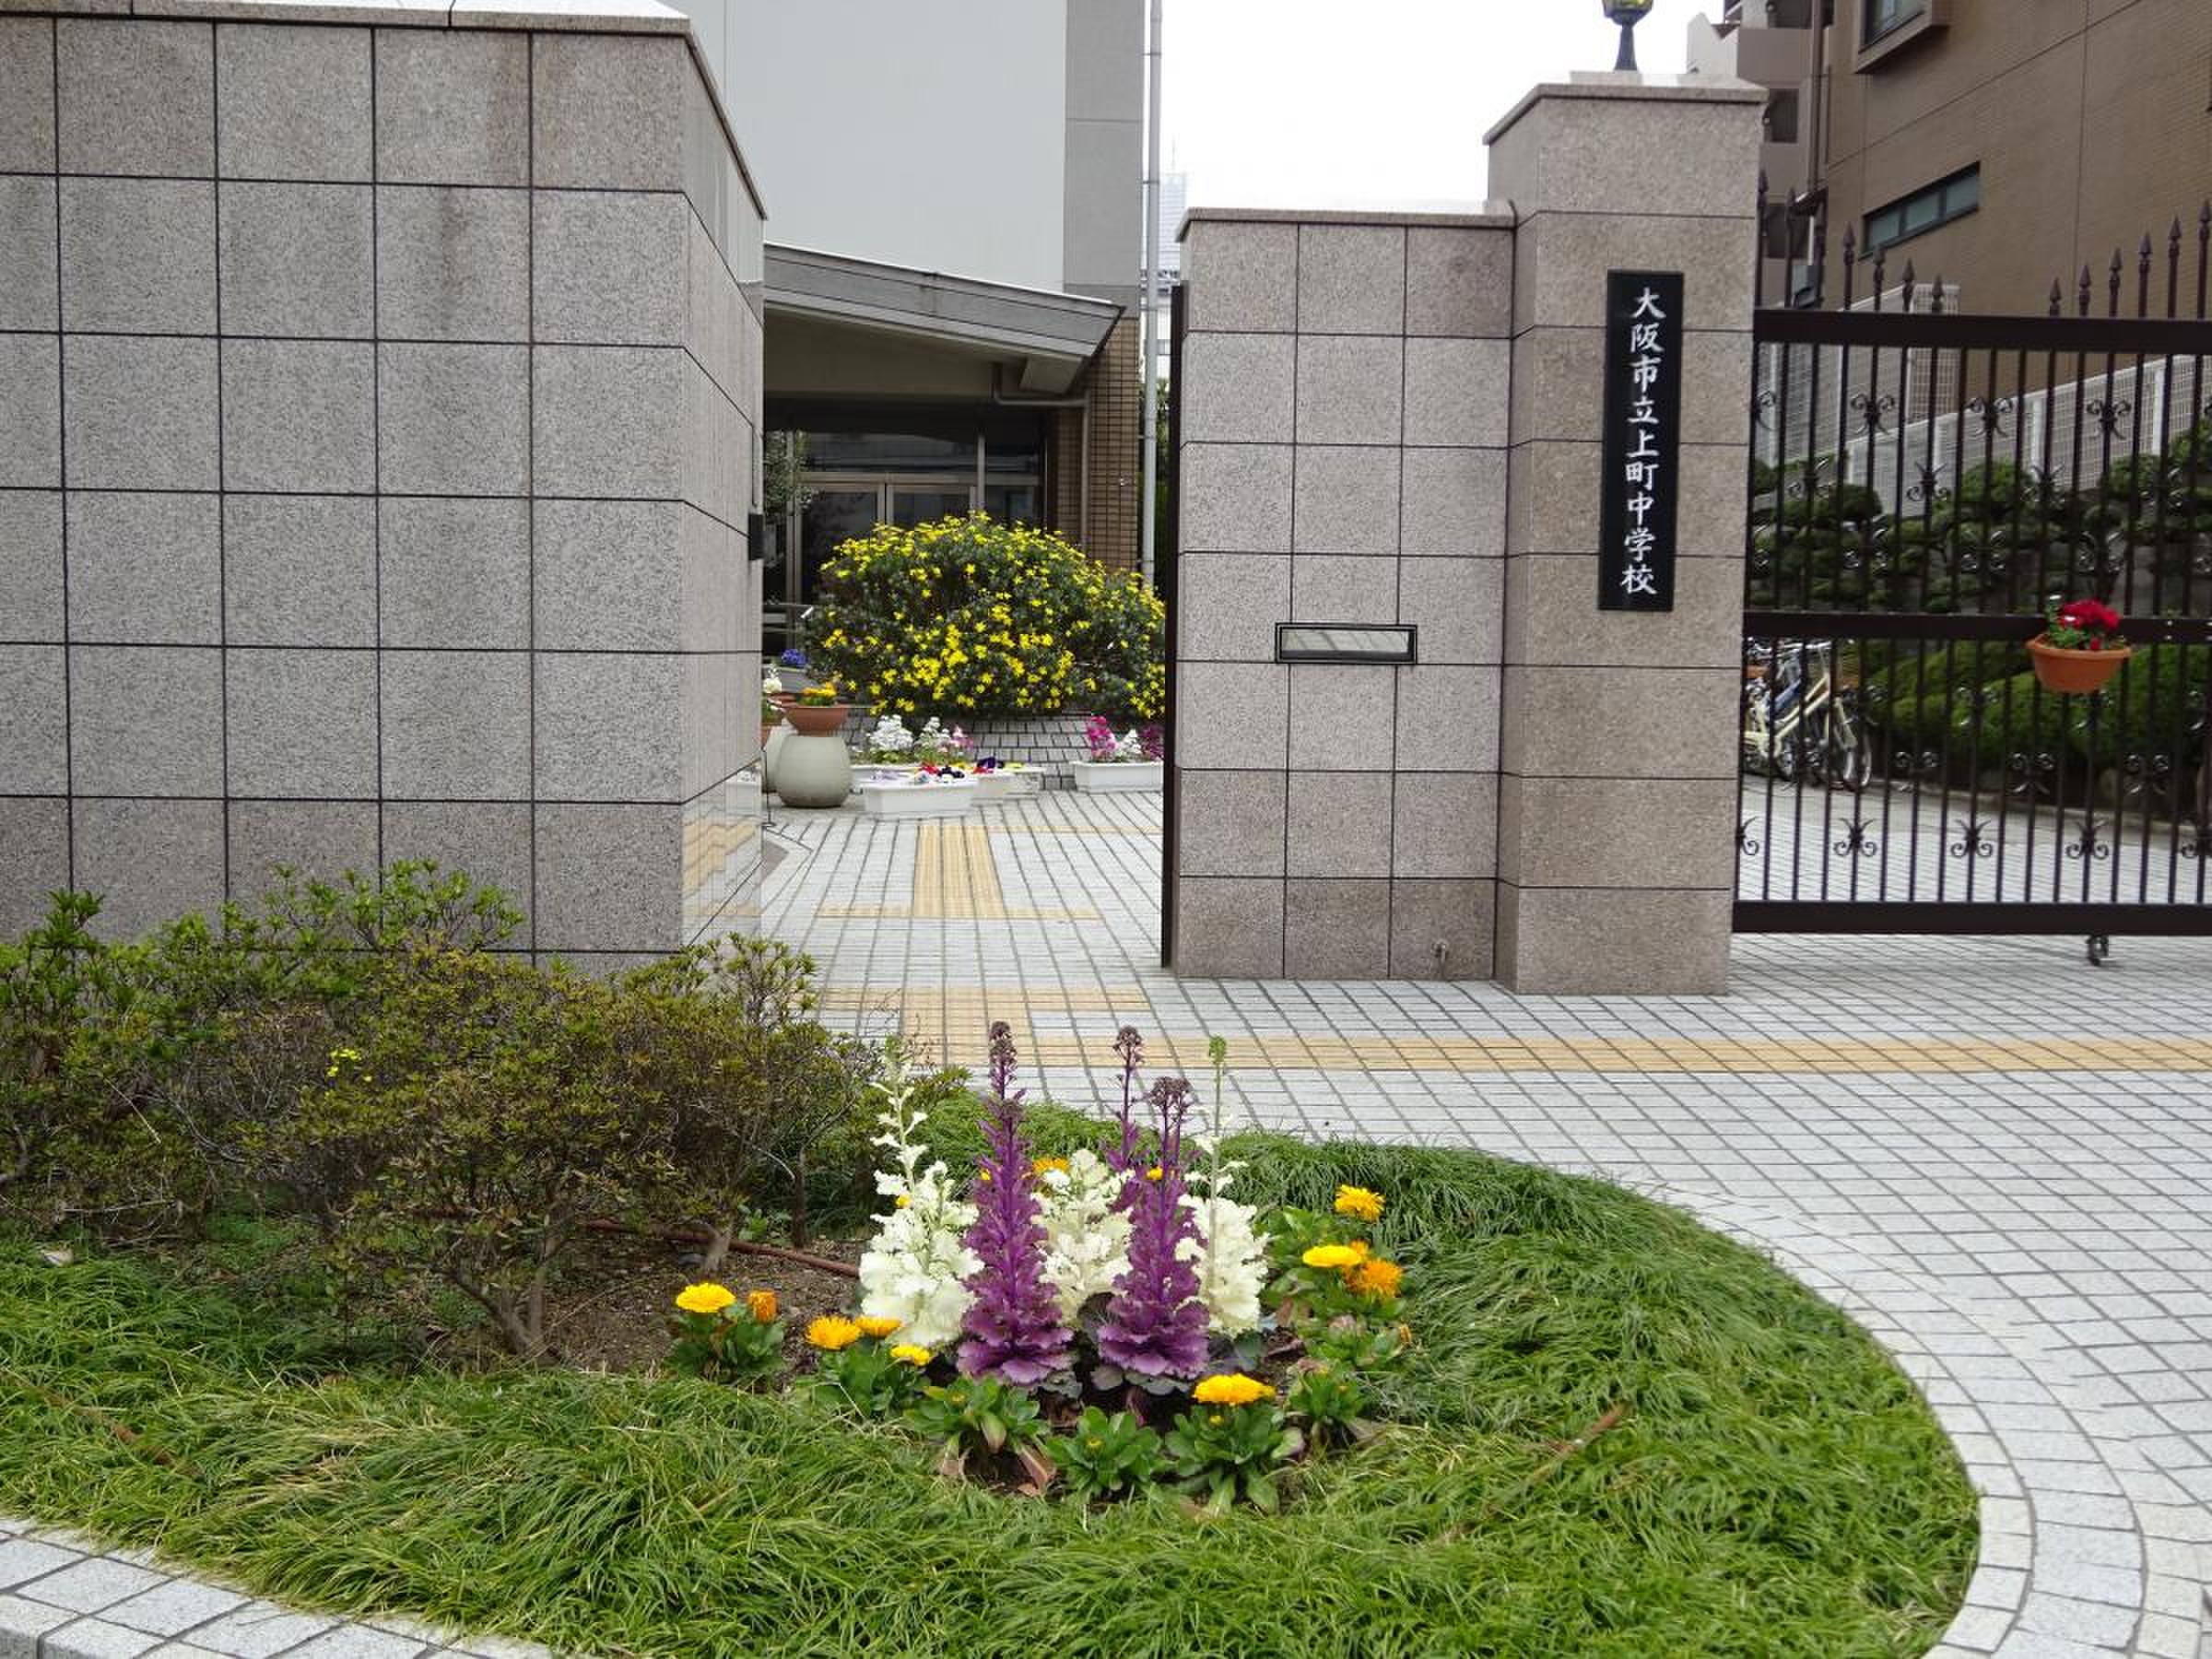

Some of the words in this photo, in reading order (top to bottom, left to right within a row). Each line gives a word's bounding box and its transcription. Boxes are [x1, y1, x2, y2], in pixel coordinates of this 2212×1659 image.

[1620, 287, 1666, 594] 大阪市立上町中学校
